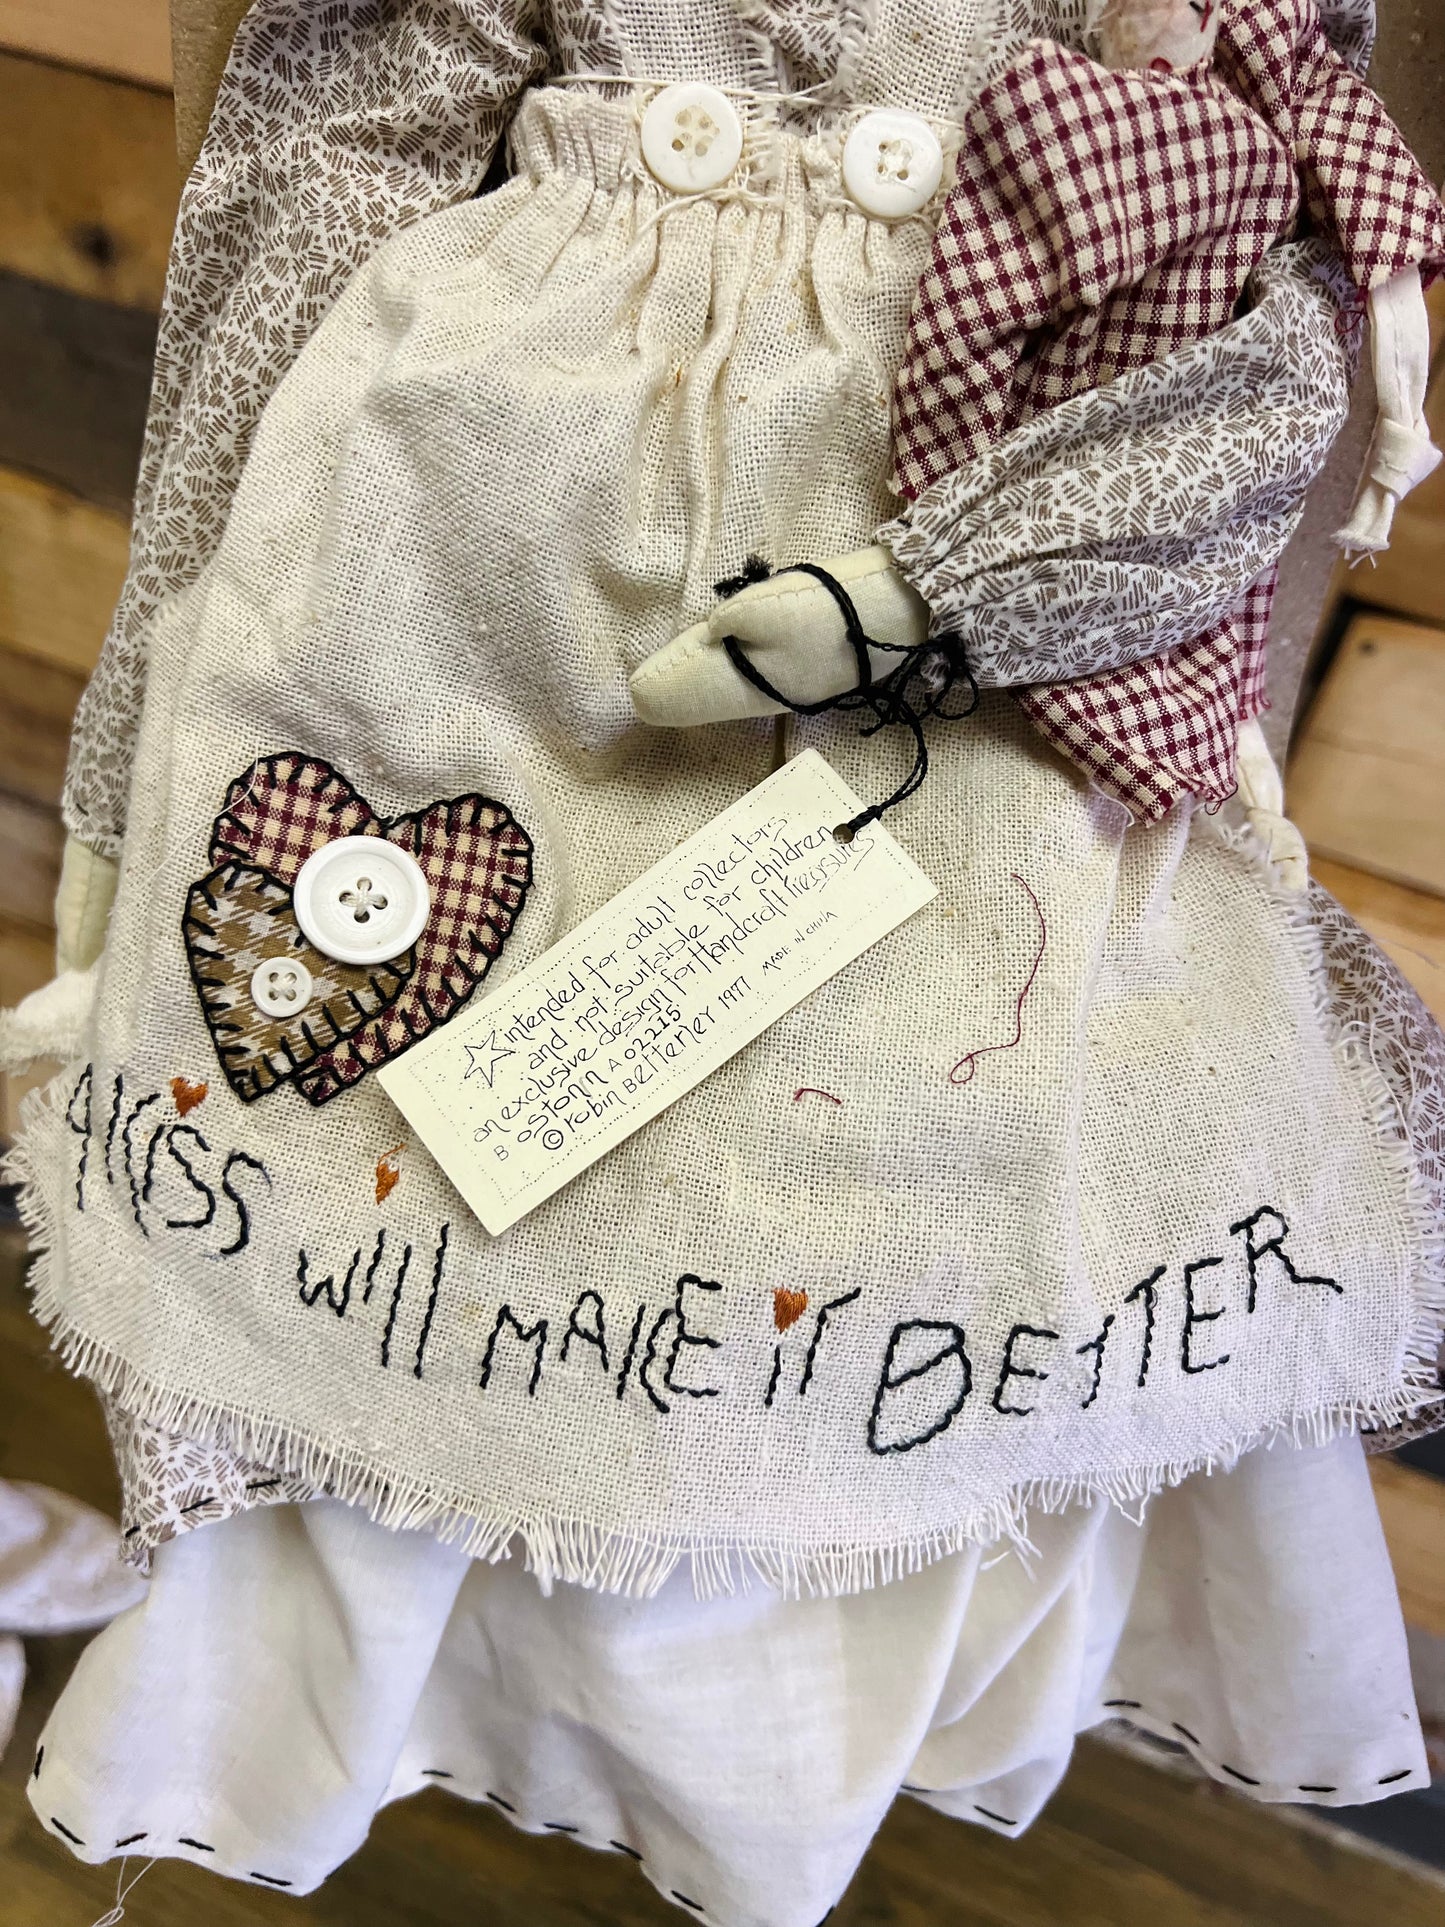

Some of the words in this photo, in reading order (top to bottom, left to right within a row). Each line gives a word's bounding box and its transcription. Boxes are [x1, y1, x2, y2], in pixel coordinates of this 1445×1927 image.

[504, 971, 586, 1044] intended
[582, 950, 616, 989] for
[626, 896, 677, 950] adult
[684, 817, 788, 900] collectors
[528, 1027, 568, 1070] and
[575, 996, 608, 1033] not
[615, 925, 709, 1006] suitable
[703, 886, 741, 917] for
[751, 826, 833, 884] children
[717, 975, 752, 1010] 1977
[762, 945, 792, 976] MADE
[806, 909, 839, 936] CHINA
[474, 1119, 511, 1143] an
[501, 1048, 598, 1120] exclusive
[599, 988, 673, 1046] design
[660, 960, 697, 996] for
[624, 1003, 682, 1060] 02215
